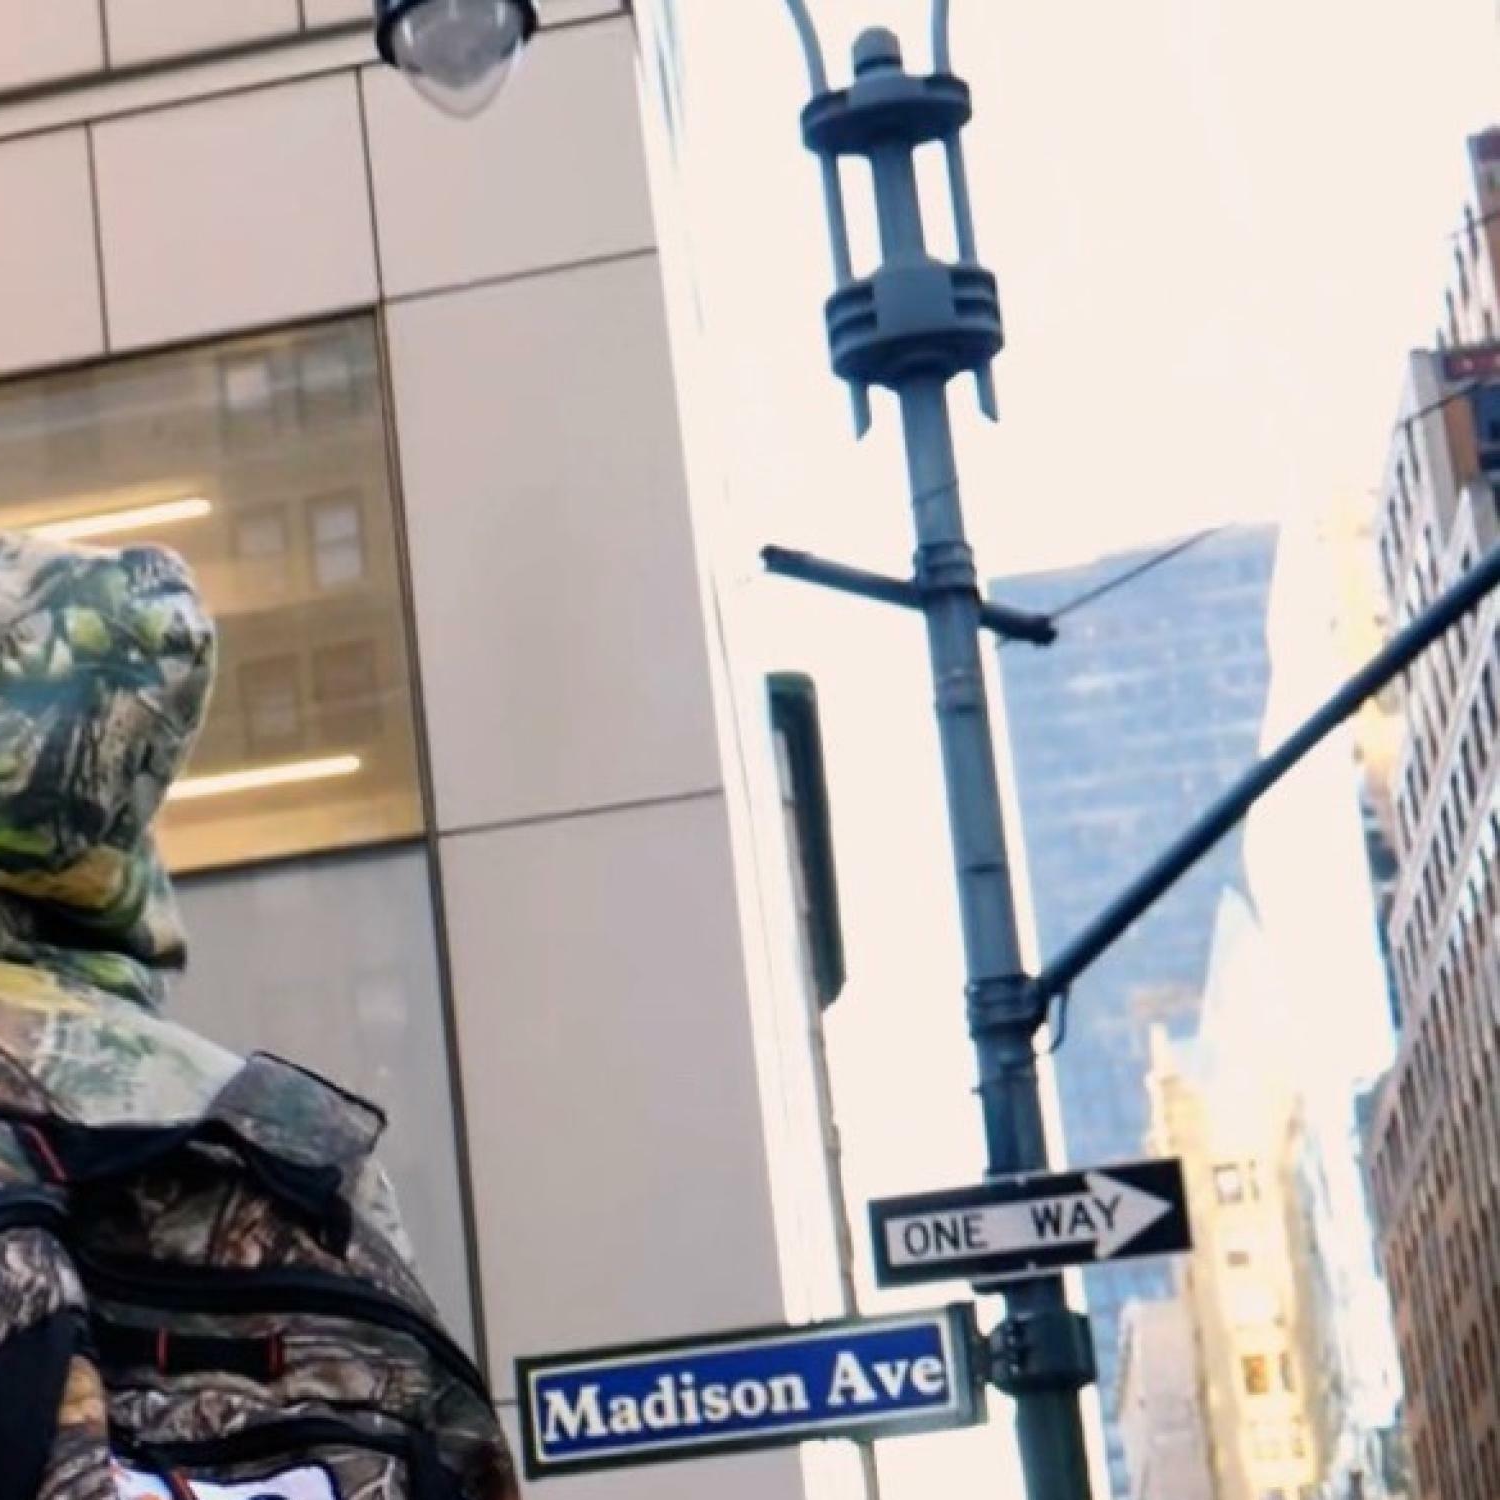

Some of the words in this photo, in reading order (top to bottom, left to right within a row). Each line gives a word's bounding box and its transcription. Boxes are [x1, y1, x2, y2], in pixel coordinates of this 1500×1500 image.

[903, 1214, 988, 1258] ONE
[1030, 1193, 1123, 1241] WAY
[541, 1371, 810, 1443] Madison
[827, 1350, 946, 1406] Ave
